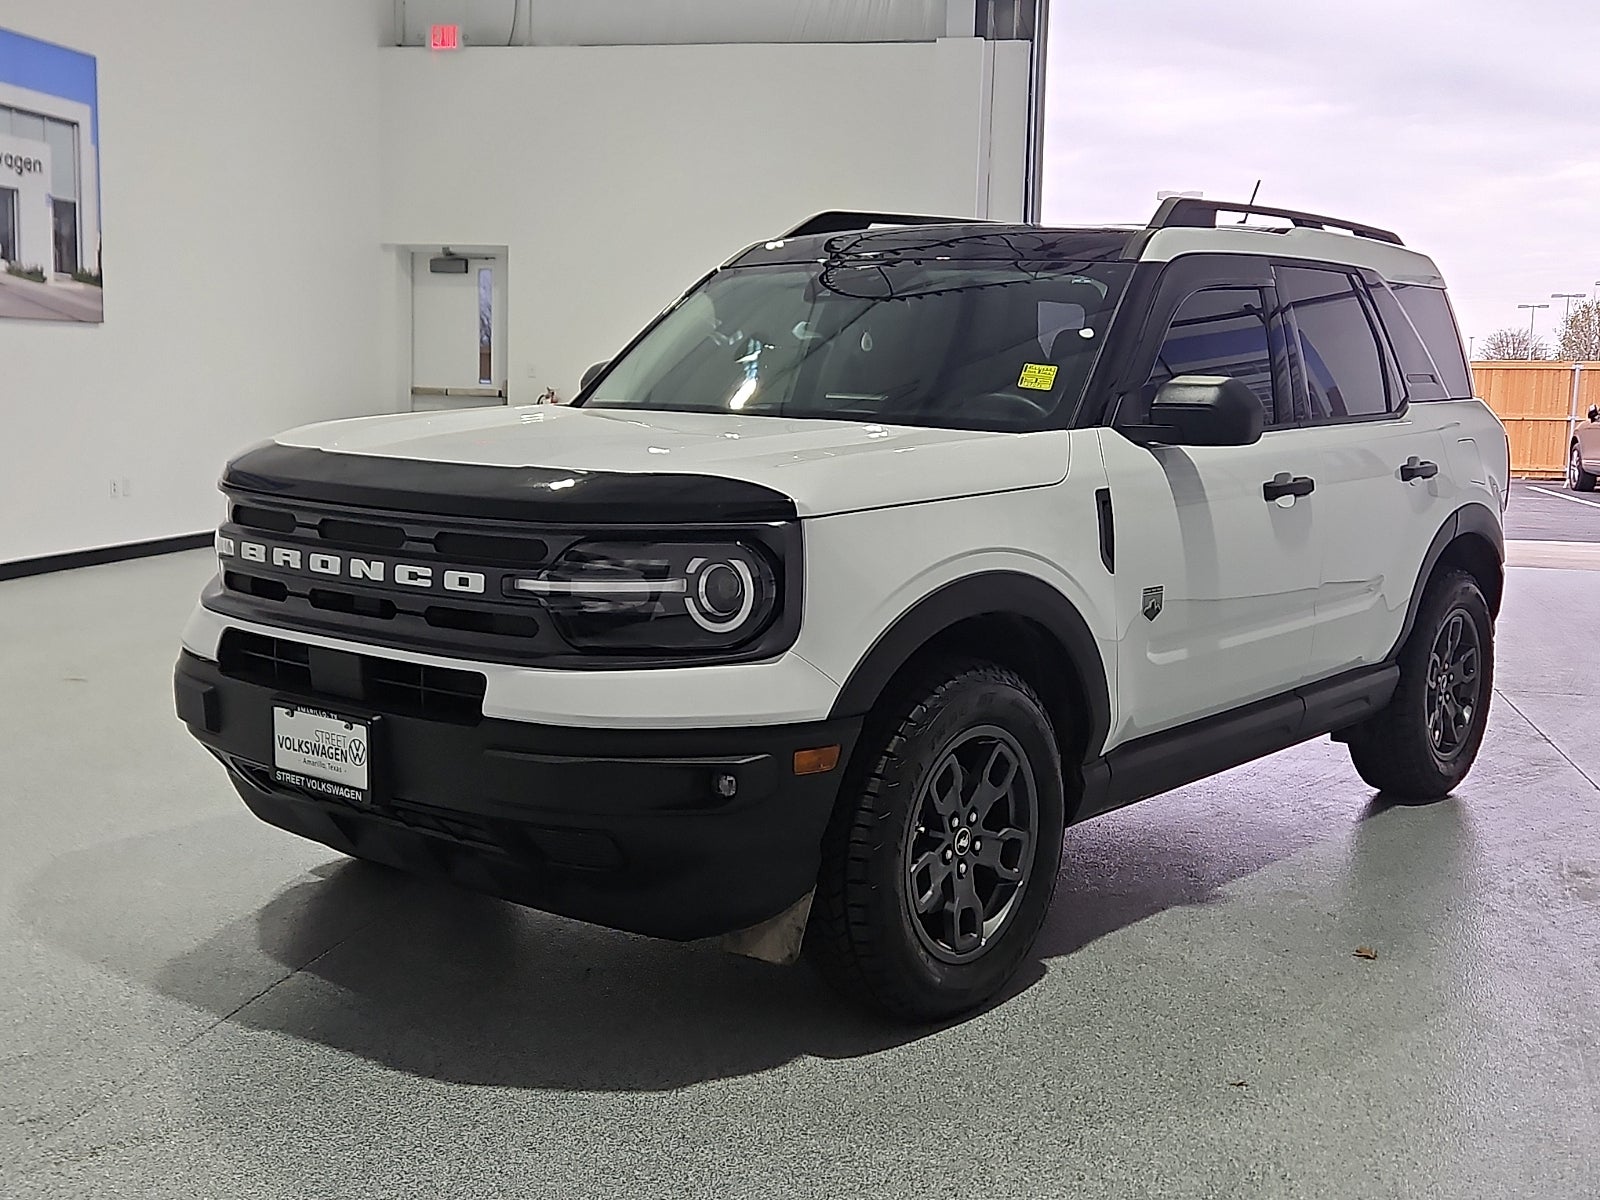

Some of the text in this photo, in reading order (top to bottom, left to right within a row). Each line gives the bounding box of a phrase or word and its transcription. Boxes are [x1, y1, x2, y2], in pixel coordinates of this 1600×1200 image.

[241, 541, 485, 594] BRONCO
[277, 734, 348, 763] VOLKSWAGEN
[315, 729, 347, 748] STREET
[275, 771, 362, 802] STREET VOLKSWAGEN
